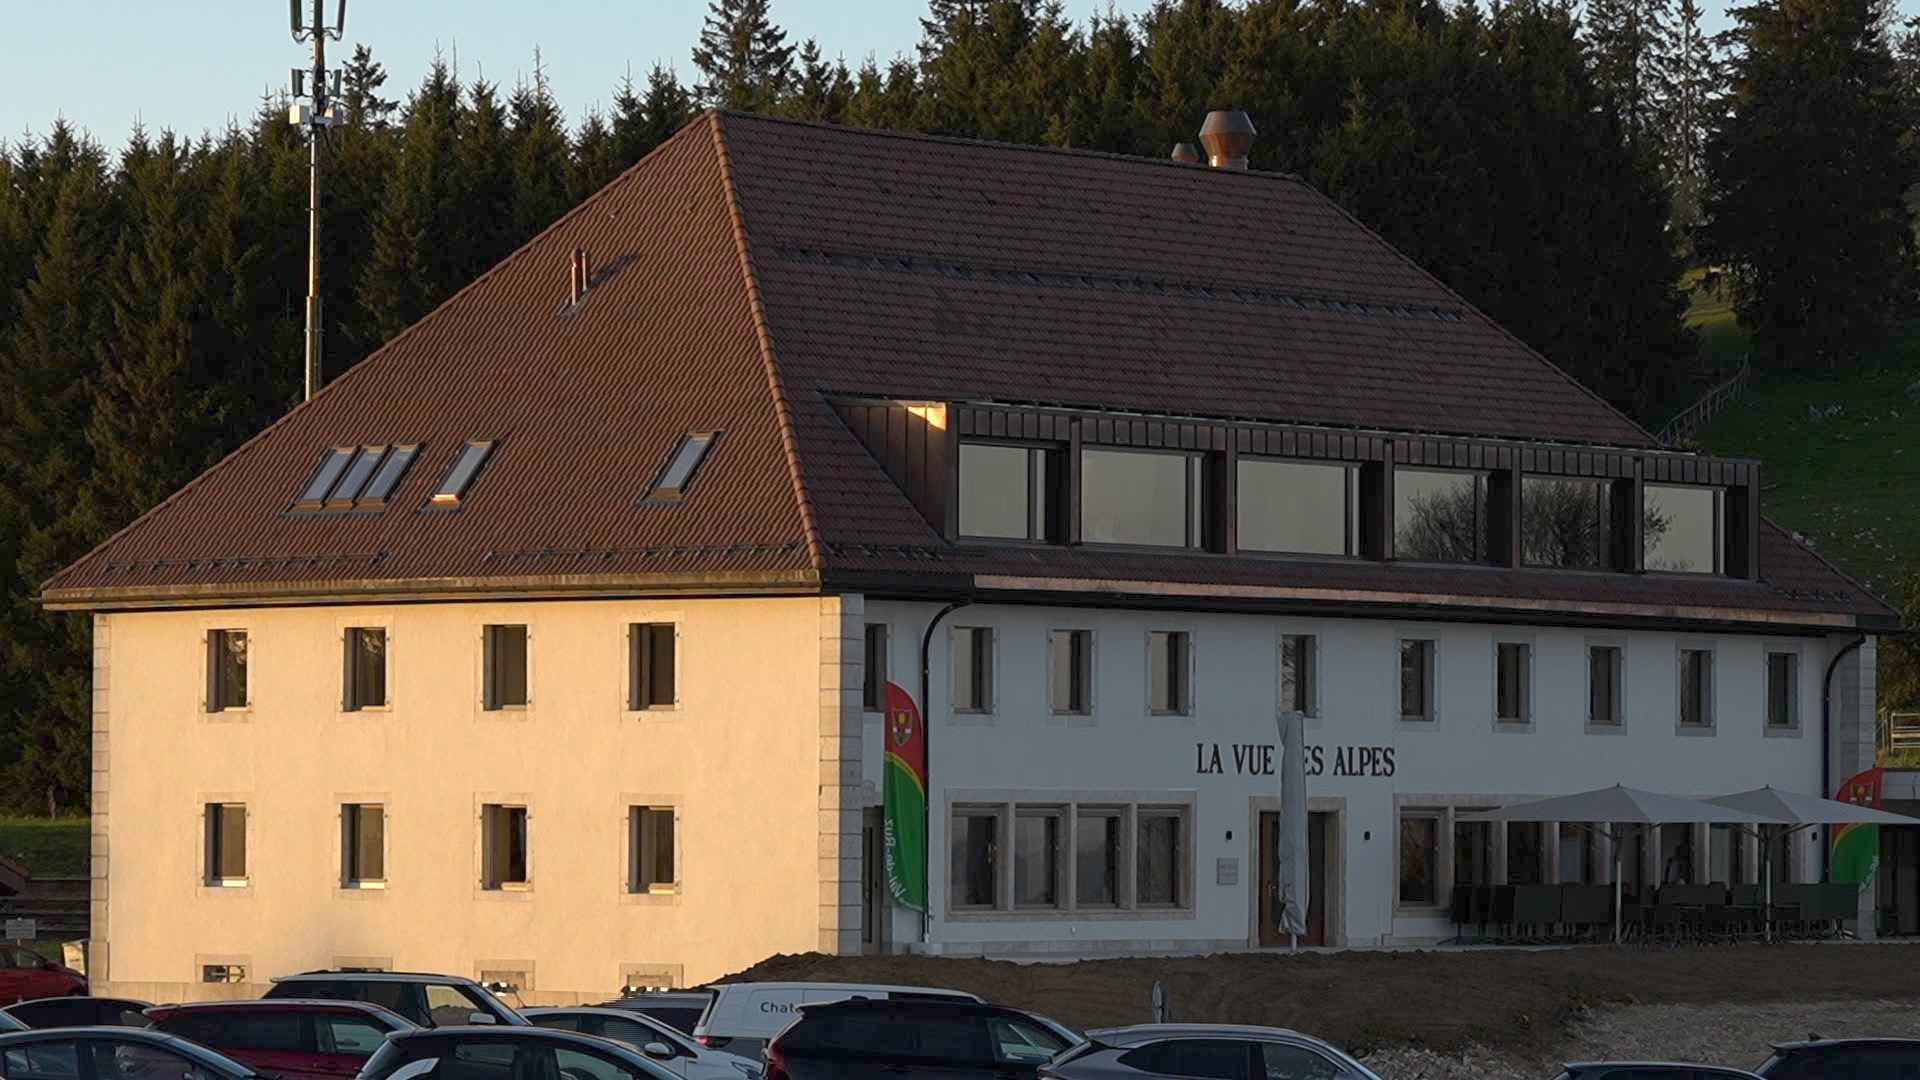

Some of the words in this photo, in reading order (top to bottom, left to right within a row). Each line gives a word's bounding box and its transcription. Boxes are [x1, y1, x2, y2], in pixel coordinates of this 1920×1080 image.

[1196, 743, 1223, 774] LA
[1232, 744, 1275, 775] VUE
[1333, 746, 1395, 777] ALPES
